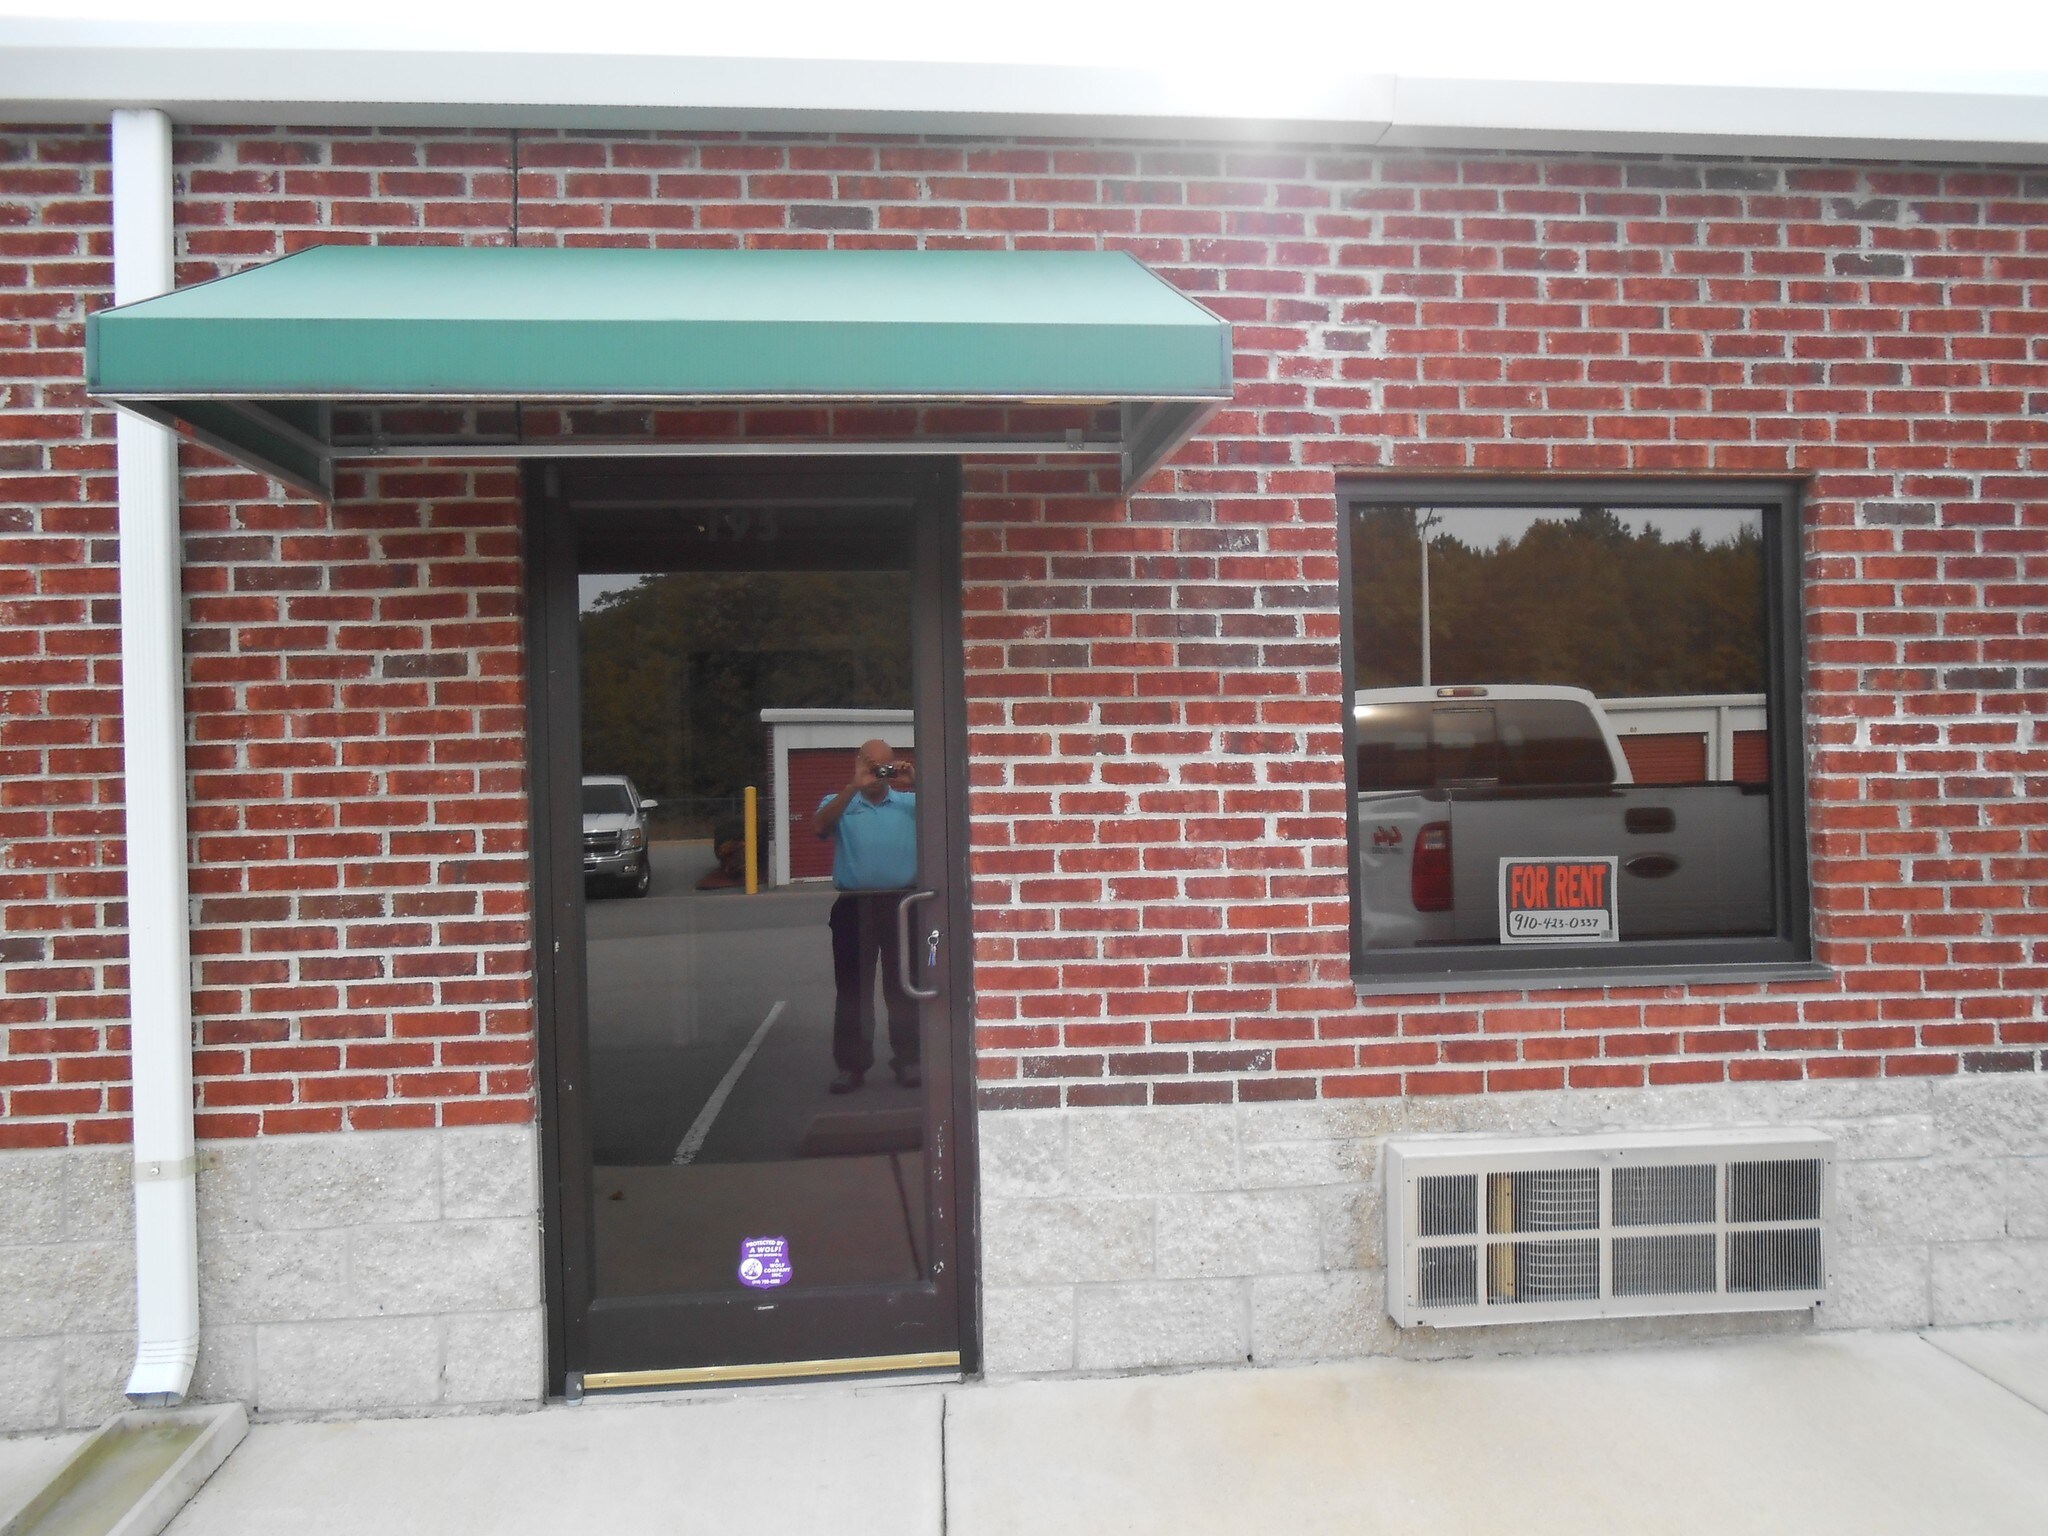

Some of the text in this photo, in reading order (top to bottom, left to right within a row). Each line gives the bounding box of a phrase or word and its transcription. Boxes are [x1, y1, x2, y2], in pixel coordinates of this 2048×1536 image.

[1512, 864, 1606, 909] FOR RENT
[1515, 914, 1599, 930] 910-423-0337
